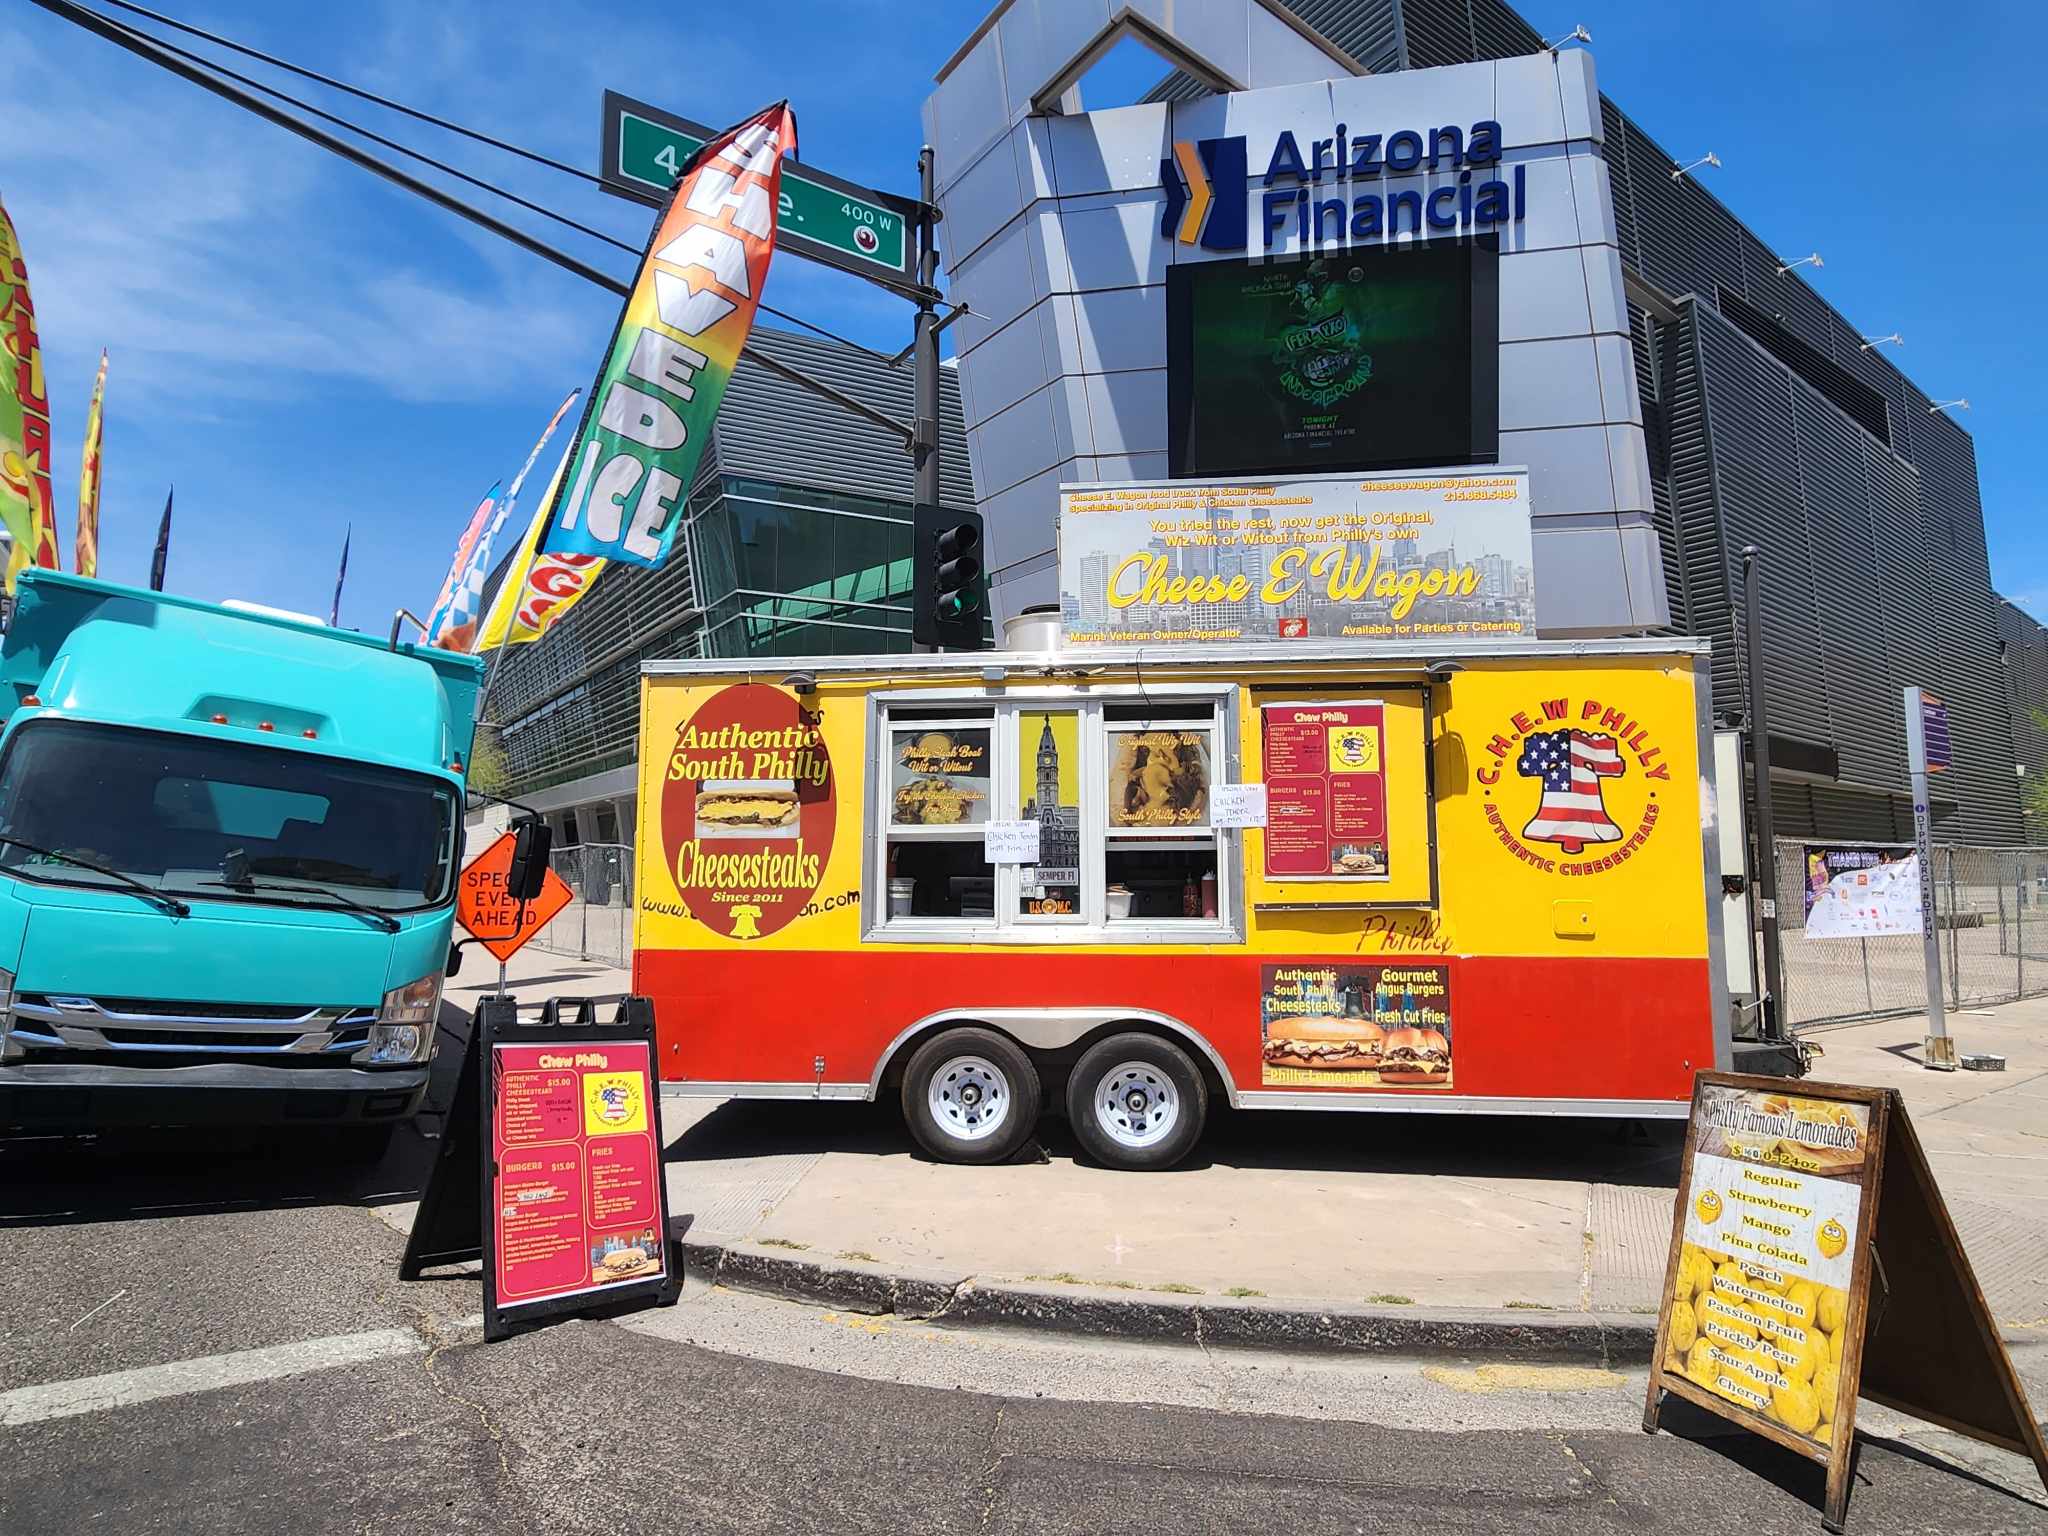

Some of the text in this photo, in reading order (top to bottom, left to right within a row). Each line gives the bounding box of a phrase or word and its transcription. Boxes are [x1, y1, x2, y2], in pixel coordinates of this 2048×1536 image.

[1263, 120, 1502, 185] Arizona
[1262, 164, 1526, 246] Financial
[841, 202, 893, 231] 400 W
[560, 440, 684, 561] ICE
[1221, 487, 1249, 496] South
[1124, 503, 1133, 511] in
[1135, 501, 1172, 512] Original
[1173, 500, 1197, 511] Philly
[1199, 500, 1207, 508] &
[1208, 497, 1247, 508] Chicken
[1248, 496, 1314, 507] Cheesesteaks
[1150, 510, 1434, 533] You tried the rest, now get the Original,
[1165, 527, 1419, 547] Wiz Wit or Witout from Philly's own
[1108, 544, 1483, 621] Cheese E Wagon
[1070, 628, 1242, 642] Marine Veteran Owner/Operator
[1342, 621, 1522, 636] Available for Parties or Catering
[1294, 711, 1349, 724] Chew Philly
[677, 723, 820, 749] Authentic
[1581, 700, 1670, 781] PHILLY
[668, 751, 829, 786] South Philly
[1118, 808, 1145, 822] South
[1145, 807, 1177, 825] Philly
[1484, 803, 1660, 876] AUTHENTIC CHEESESTEAKS
[676, 838, 820, 889] Cheesesteaks
[1039, 871, 1075, 881] SEMPER FI
[711, 892, 784, 903] Since 2011
[472, 910, 537, 926] AHEAD
[1275, 969, 1438, 983] Authentic Gourmet
[1273, 983, 1444, 999] South Philly Angus Burgers
[1266, 997, 1342, 1013] Cheesesteaks
[1375, 1010, 1446, 1024] Fresh Cut Fries
[538, 1053, 608, 1069] Chew Philly
[1708, 1100, 1858, 1149] Philly Famous Lemonades
[591, 1147, 613, 1157] FRIES
[505, 1161, 543, 1173] BURGERS
[1744, 1170, 1802, 1191] Regular
[1728, 1189, 1812, 1218] Strawberry
[1742, 1215, 1791, 1236] Mango
[1757, 1242, 1809, 1266] Colada
[1739, 1261, 1783, 1283] Peach
[1713, 1276, 1804, 1317] Watermelon
[1707, 1298, 1806, 1344] Passion Fruit
[1707, 1322, 1799, 1366] Prickly Pear
[1709, 1347, 1789, 1388] Sour Apple
[1717, 1375, 1771, 1409] Cherry
